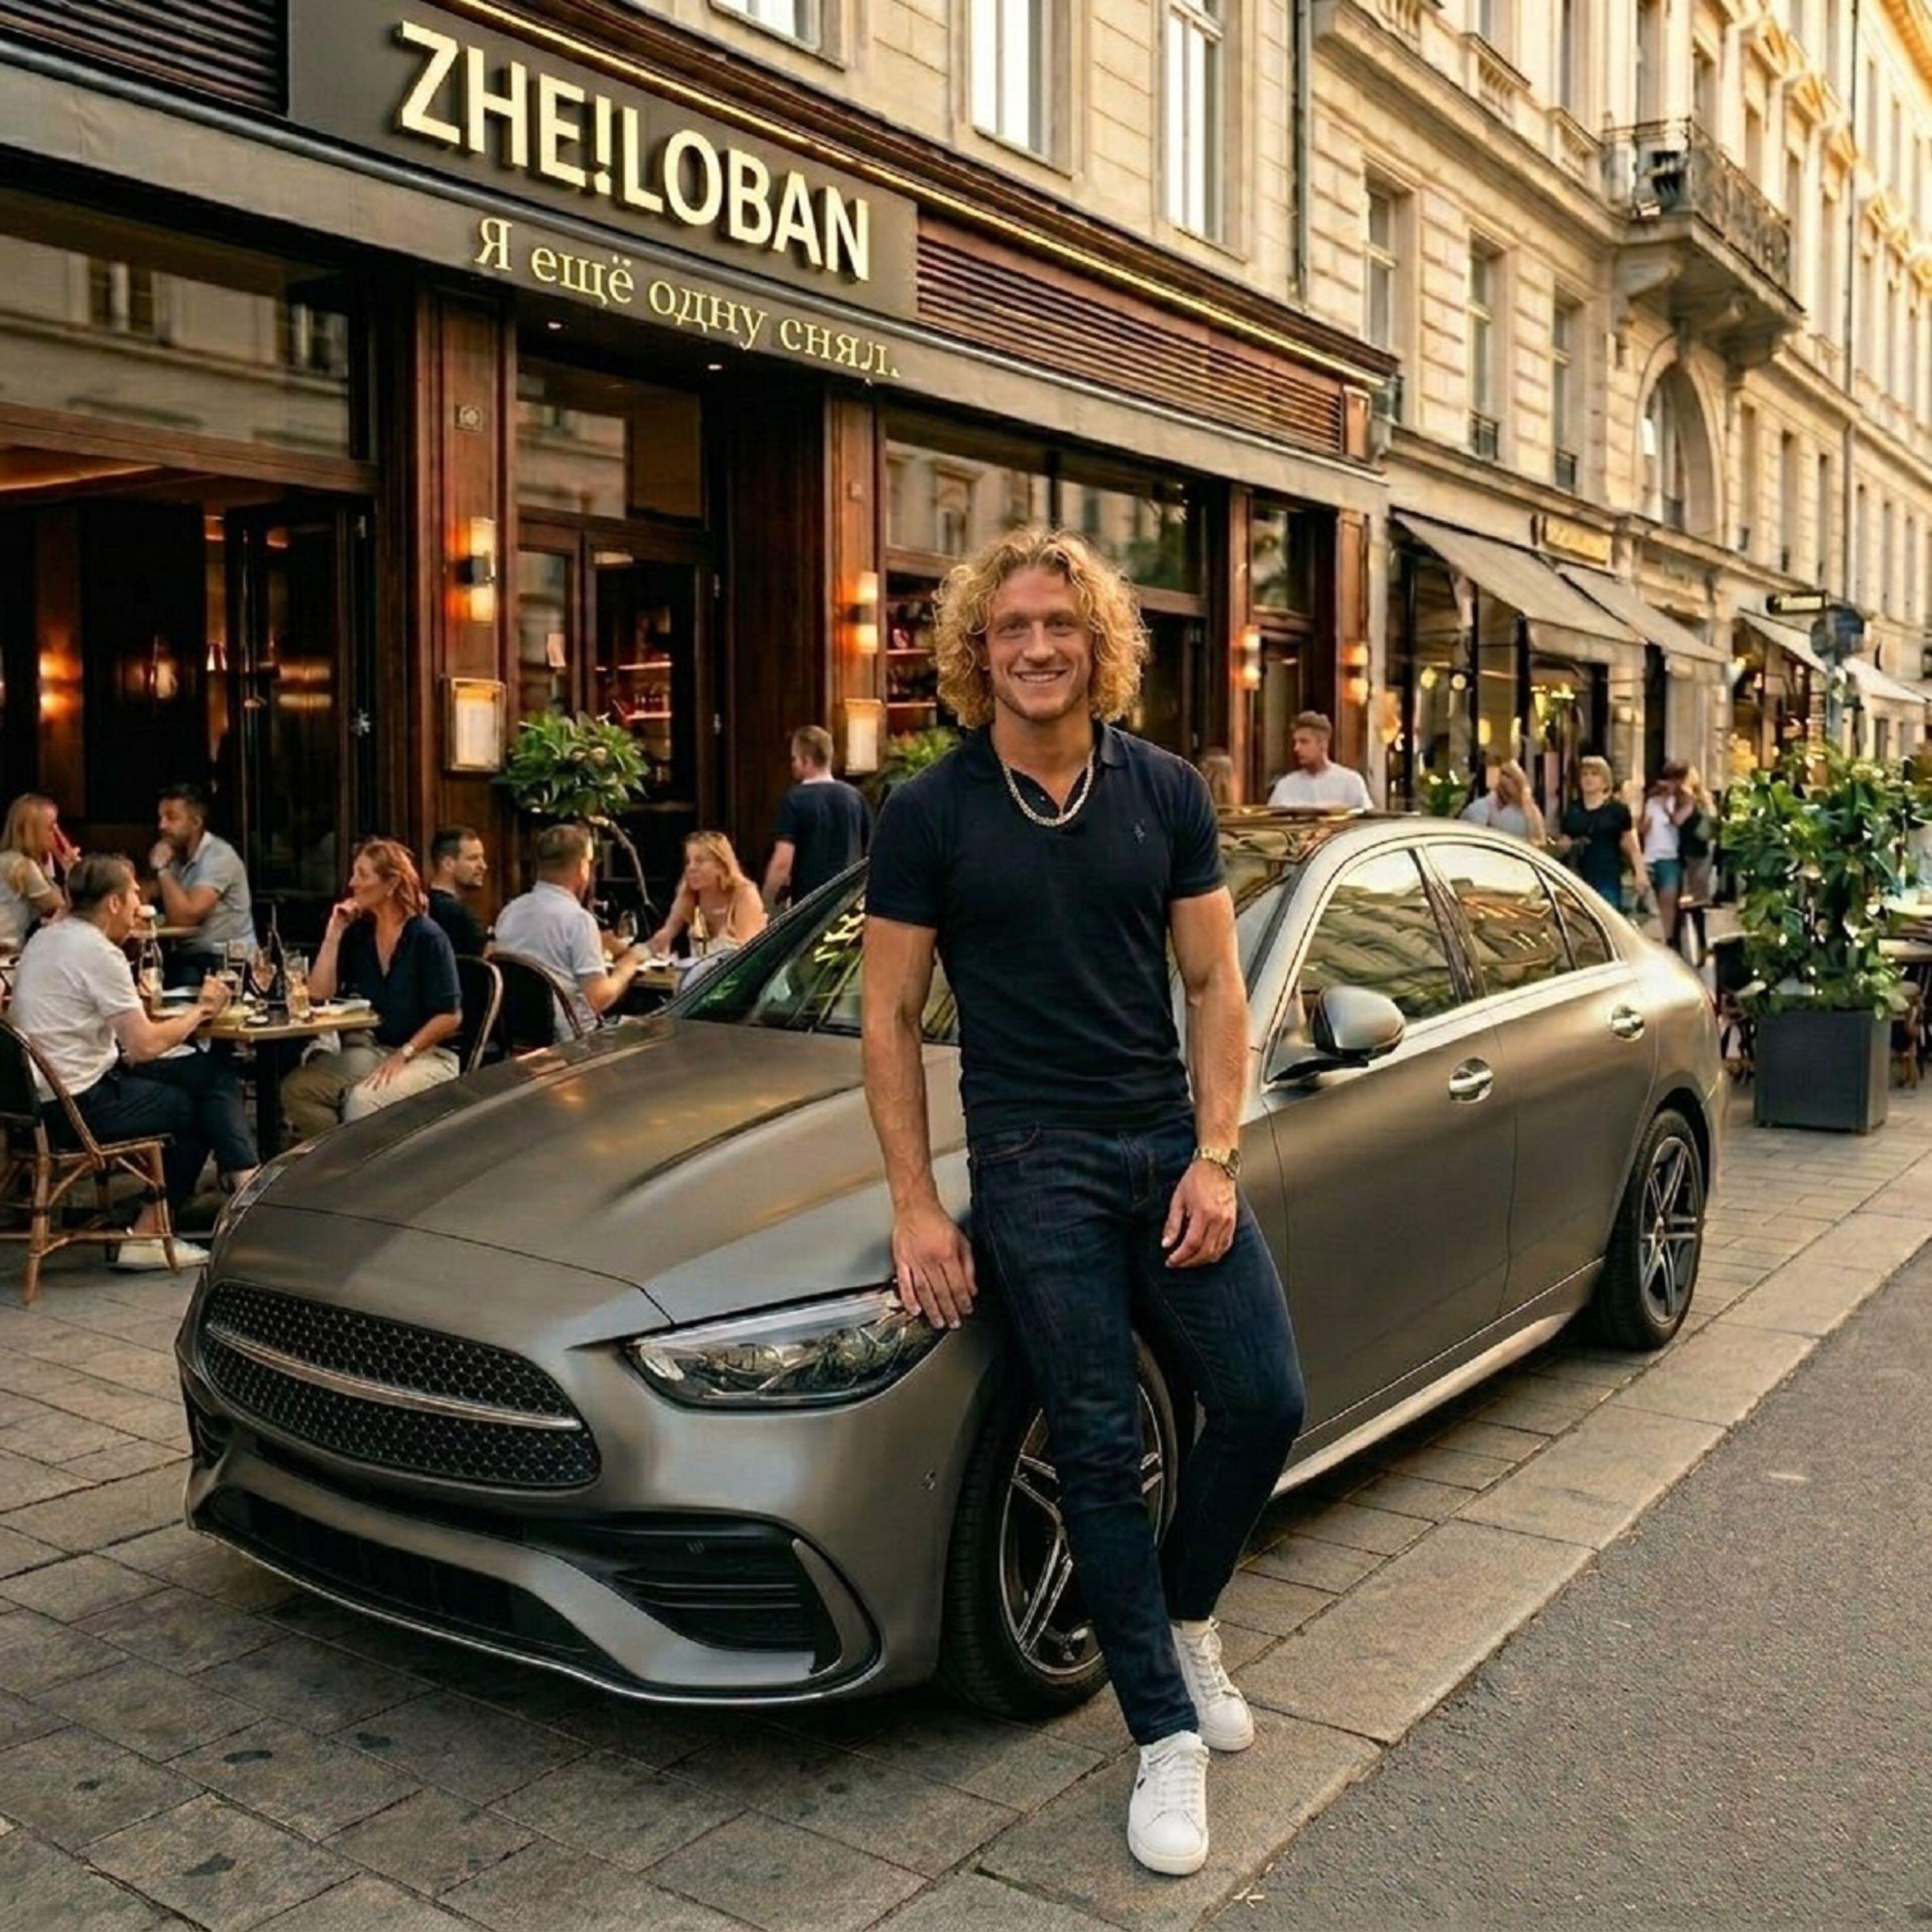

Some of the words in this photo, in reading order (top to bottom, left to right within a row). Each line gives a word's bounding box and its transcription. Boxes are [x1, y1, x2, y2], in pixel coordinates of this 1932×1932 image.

[399, 19, 870, 282] ZHE!LOBAN
[475, 216, 513, 271] Я
[531, 246, 634, 307] ещё
[649, 279, 768, 349] одну
[779, 317, 901, 379] снял.
